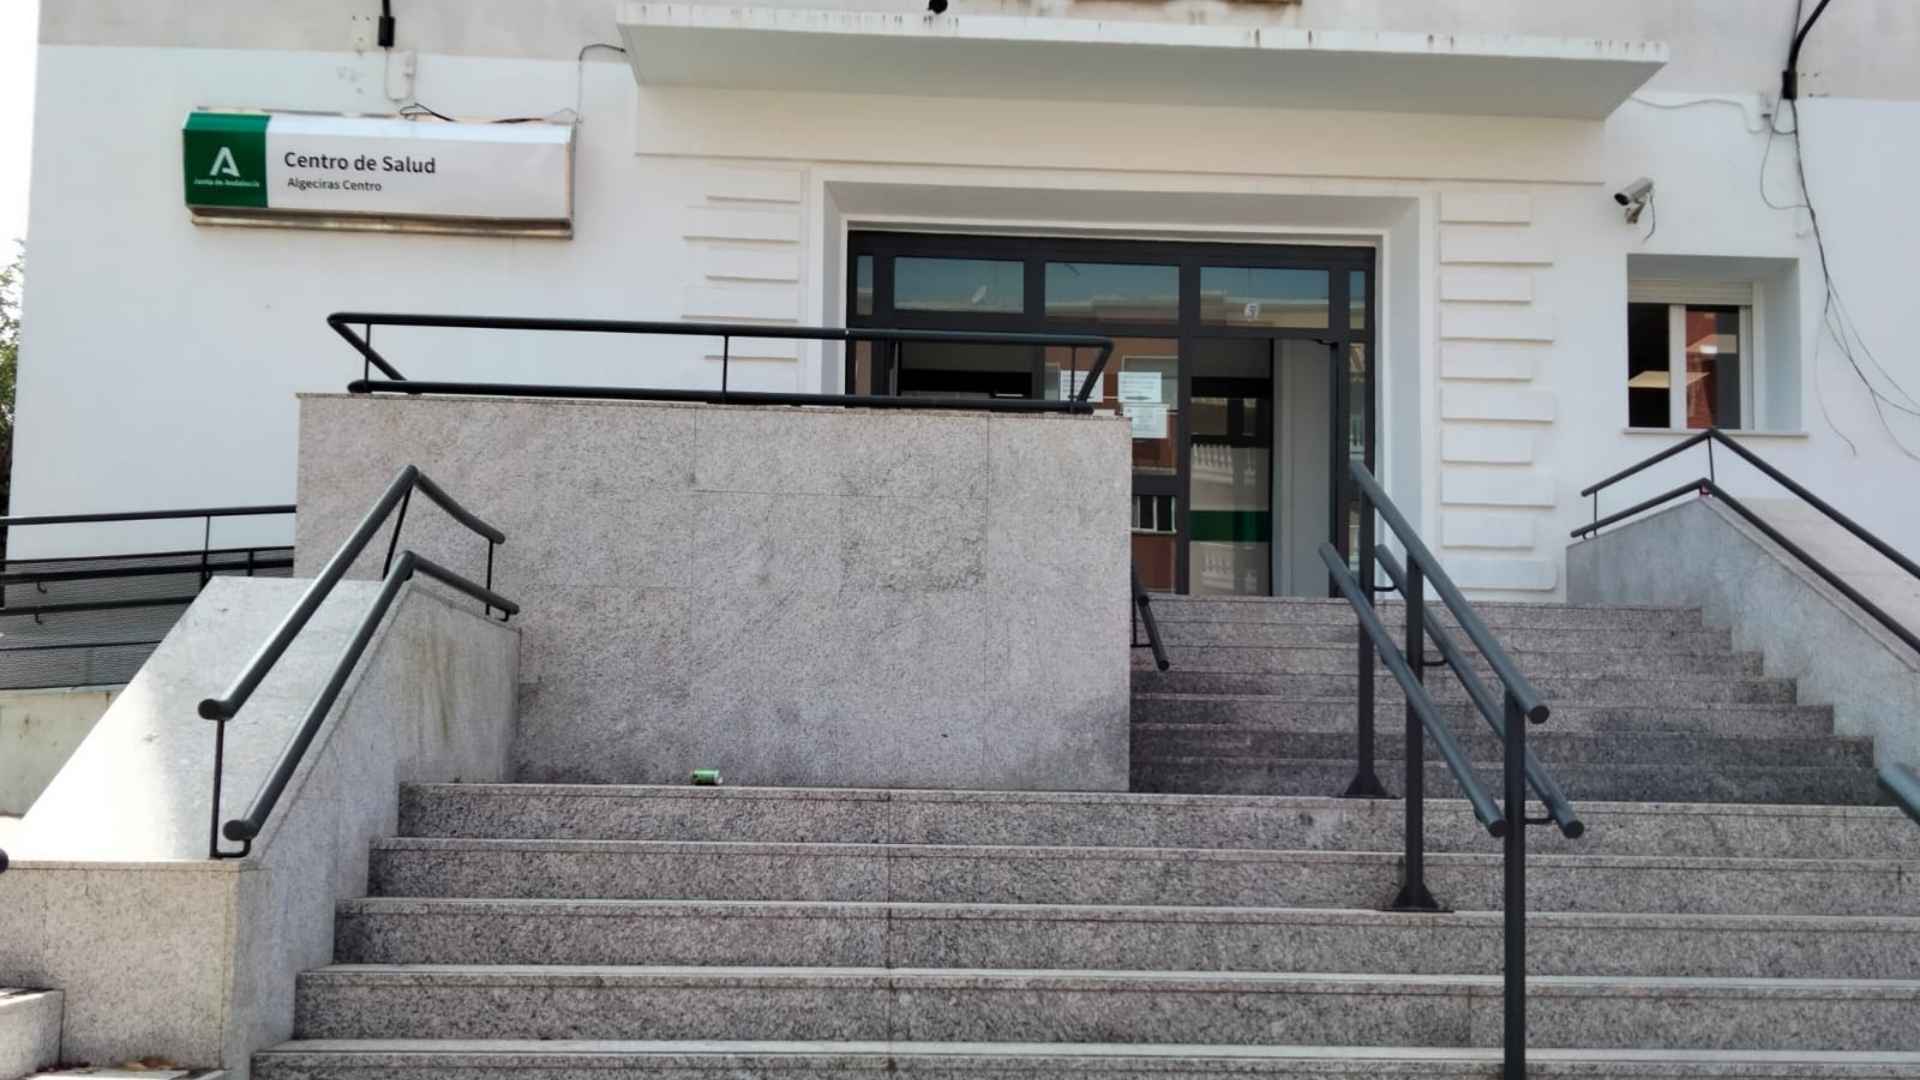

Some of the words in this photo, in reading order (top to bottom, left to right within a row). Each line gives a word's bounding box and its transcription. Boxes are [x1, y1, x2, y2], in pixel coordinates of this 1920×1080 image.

[284, 152, 349, 170] Centro
[354, 154, 377, 171] de
[382, 156, 436, 174] Salud
[288, 177, 340, 190] Algeciras
[342, 180, 382, 191] Centro
